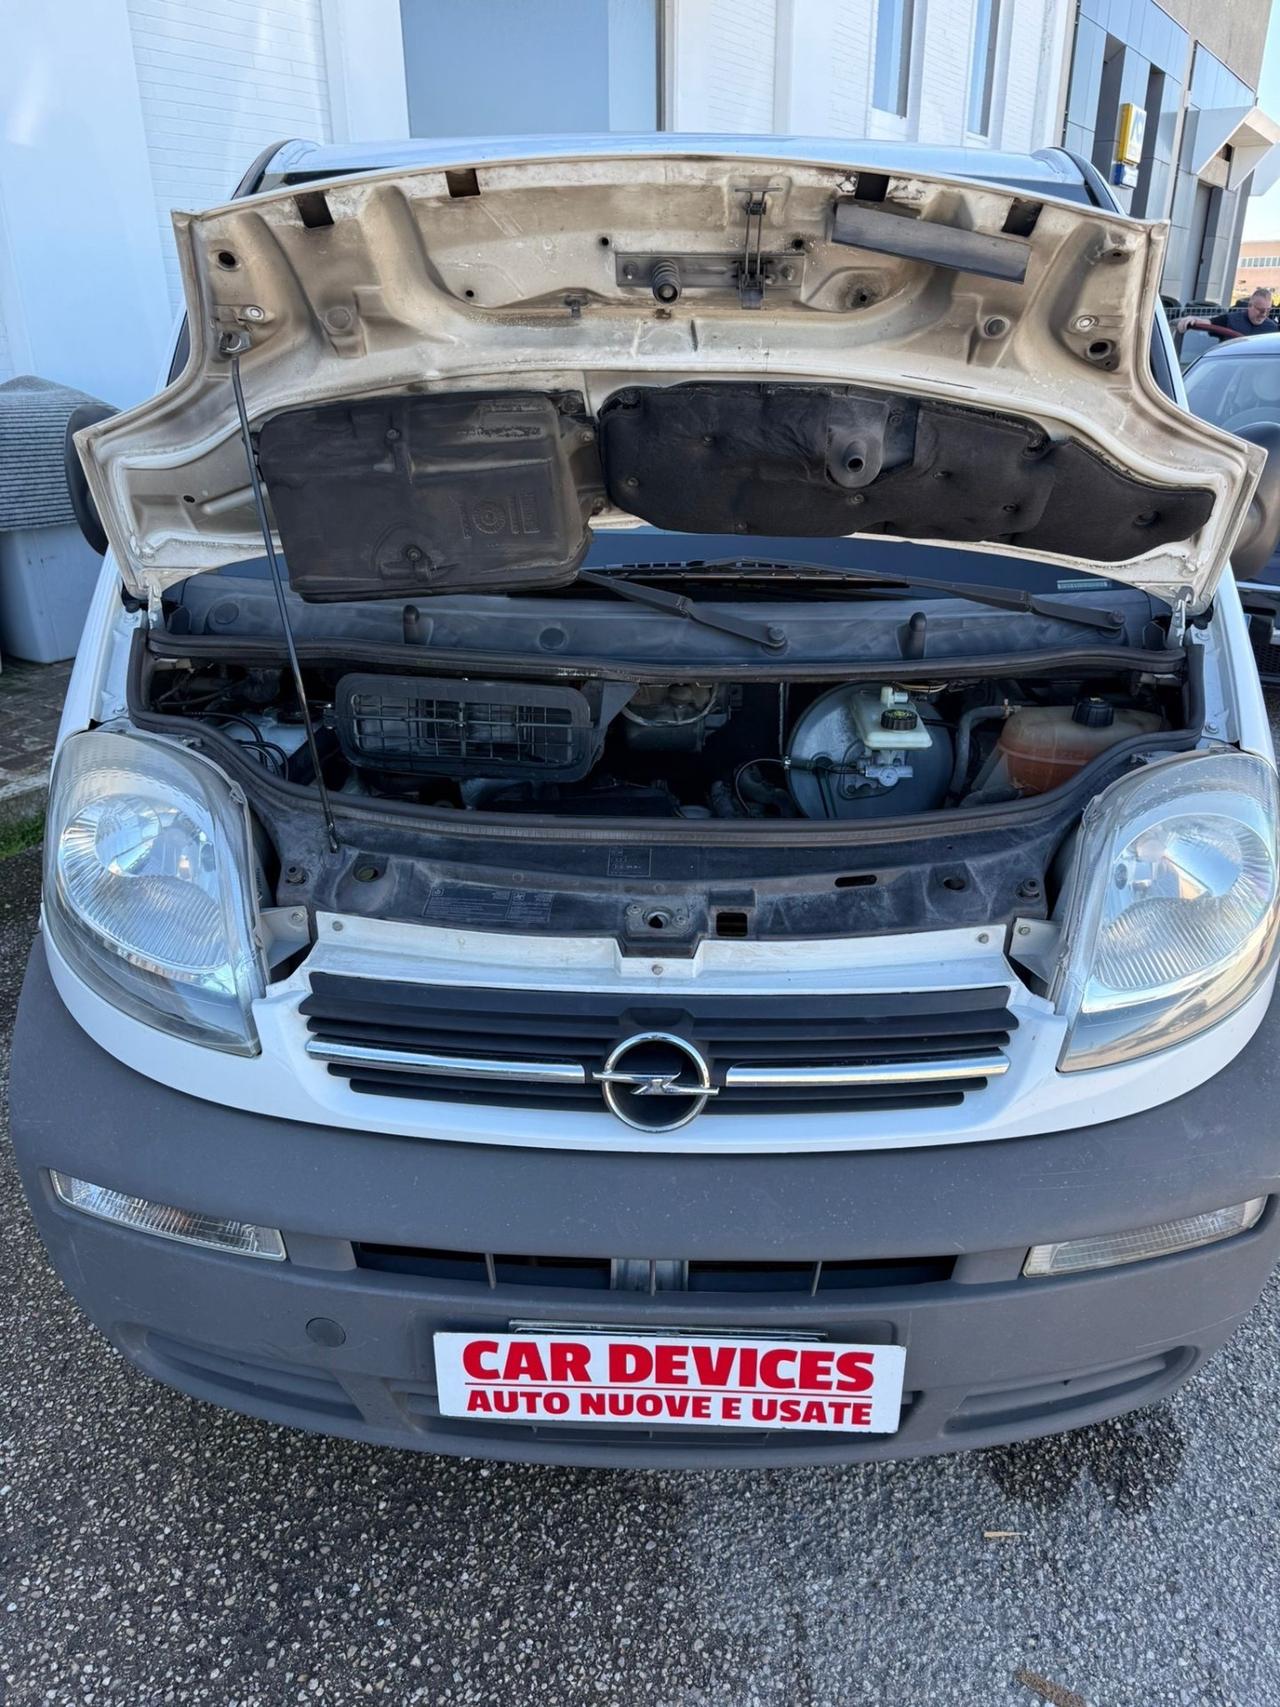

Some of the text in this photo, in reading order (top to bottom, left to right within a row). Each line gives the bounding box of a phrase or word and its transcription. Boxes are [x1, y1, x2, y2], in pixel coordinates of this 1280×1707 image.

[462, 1340, 874, 1393] CAR DEVICES
[467, 1390, 872, 1425] AUTO NUOVE E USATE
